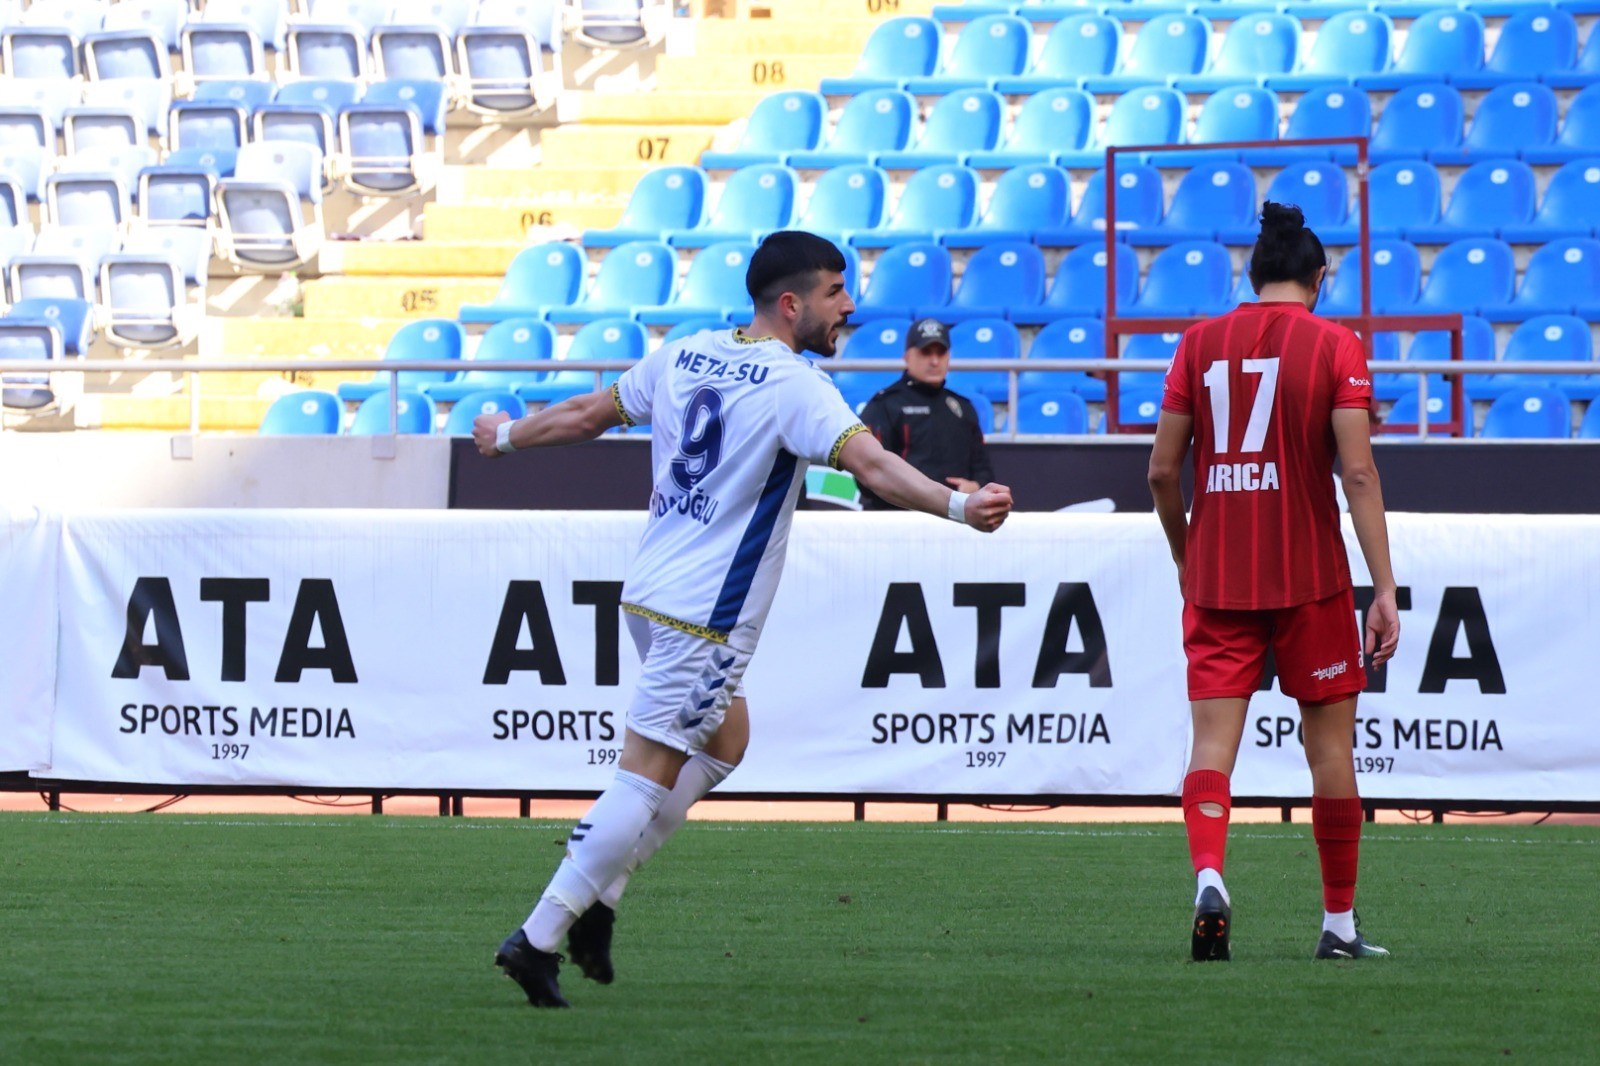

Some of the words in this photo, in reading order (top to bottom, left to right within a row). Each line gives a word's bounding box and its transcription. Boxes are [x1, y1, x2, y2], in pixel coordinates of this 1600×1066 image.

[753, 61, 786, 84] 08
[638, 138, 670, 160] 07
[675, 349, 769, 384] META-SU
[1203, 357, 1280, 454] 17
[670, 385, 725, 494] 9
[1206, 462, 1280, 493] ARICA
[111, 576, 359, 683] ATA
[482, 579, 625, 687] AT
[860, 582, 1113, 689] ATA
[119, 703, 239, 737] SPORTS
[249, 707, 356, 739] MEDIA
[493, 709, 615, 742] SPORTS
[871, 712, 996, 744] SPORTS
[1007, 712, 1111, 744] MEDIA
[1393, 718, 1504, 751] MEDIA
[212, 743, 250, 760] 1997
[966, 751, 1007, 768] 1997
[1355, 757, 1395, 774] 1997
